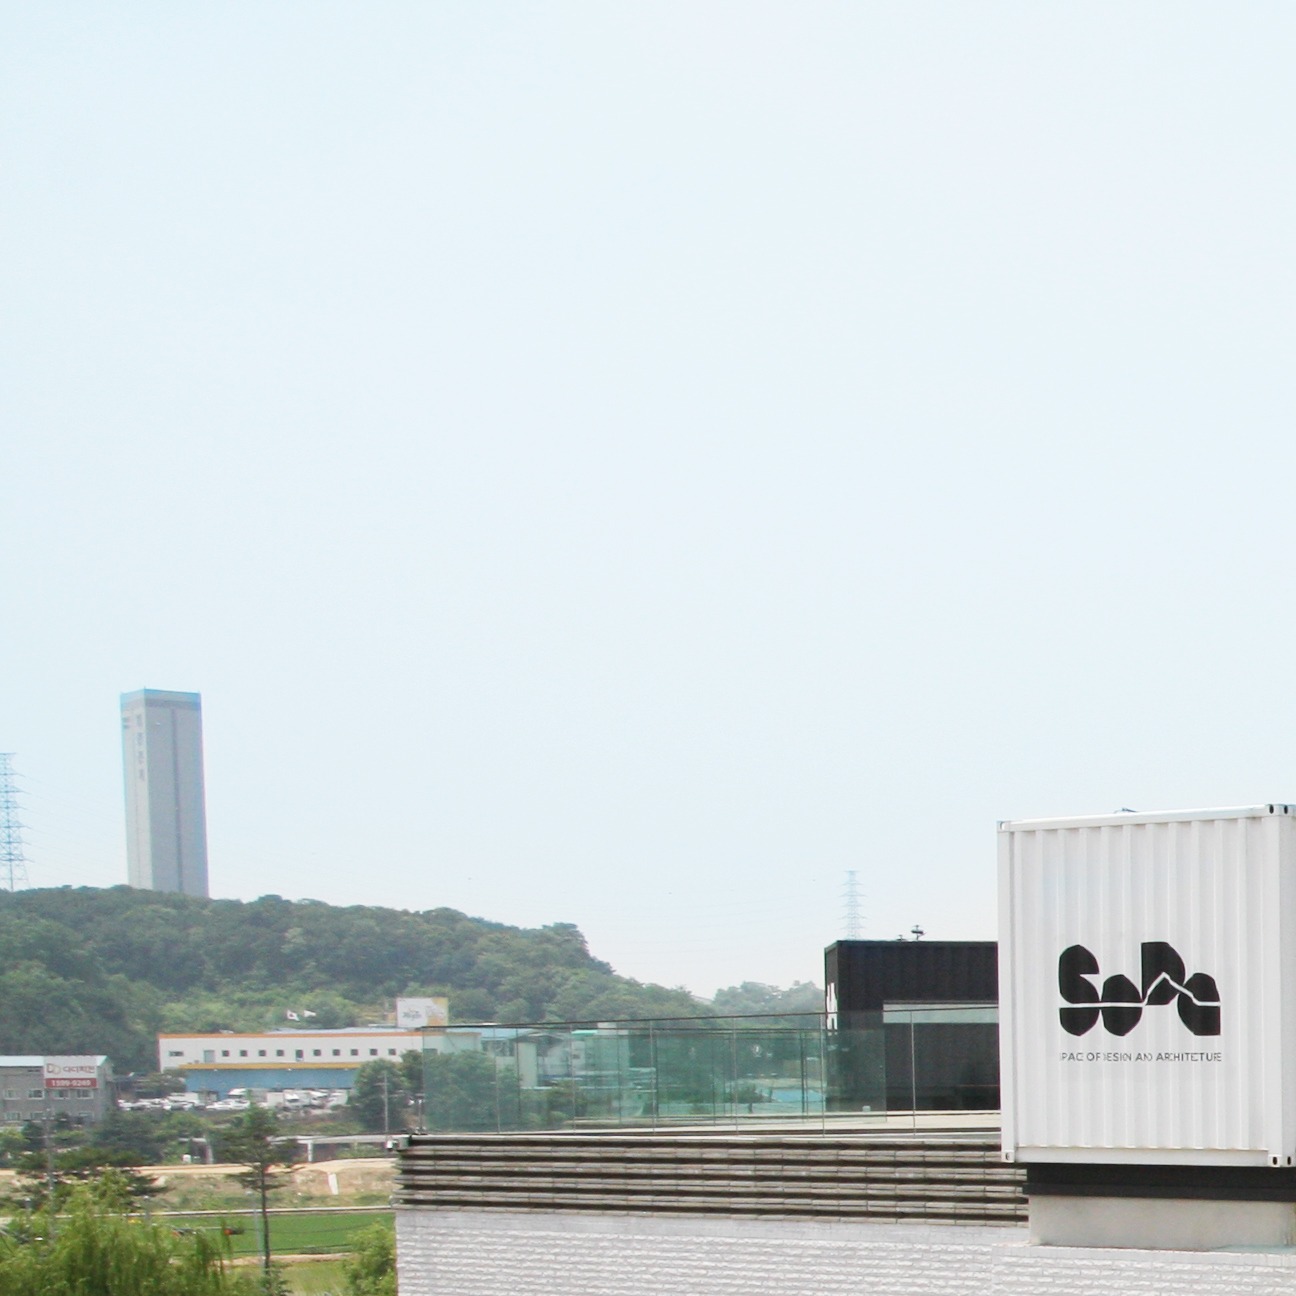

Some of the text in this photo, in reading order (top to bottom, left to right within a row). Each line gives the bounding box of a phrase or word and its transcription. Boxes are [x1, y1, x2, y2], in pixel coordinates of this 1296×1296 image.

[1060, 1052, 1083, 1062] PAC
[1087, 1052, 1100, 1062] OF
[1103, 1052, 1132, 1062] ESIGN
